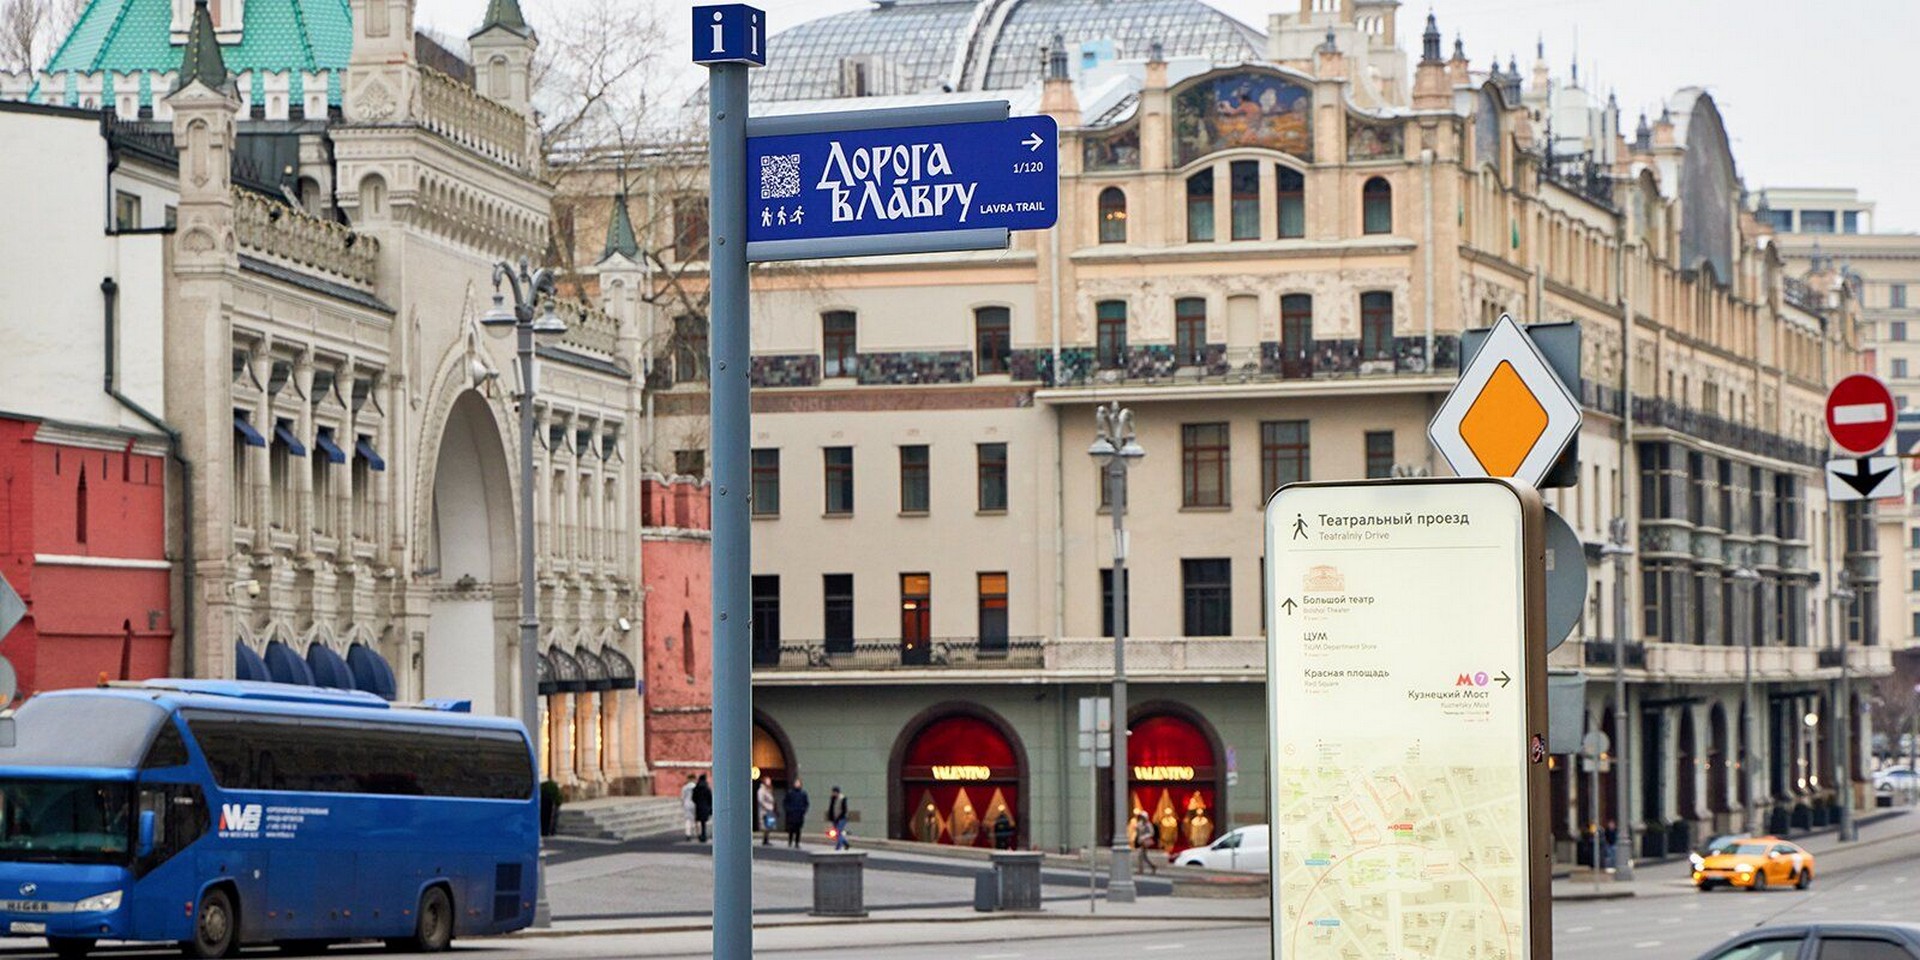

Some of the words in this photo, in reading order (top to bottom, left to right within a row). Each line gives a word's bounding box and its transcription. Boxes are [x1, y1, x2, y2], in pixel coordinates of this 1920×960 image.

[1013, 161, 1044, 174] 1/120
[980, 203, 1014, 214] LAVRA
[1016, 201, 1045, 212] TRAIL
[1318, 512, 1413, 528] Театральный
[1417, 514, 1470, 527] проезд
[1365, 531, 1390, 540] Drive
[1303, 595, 1346, 604] Большой
[1348, 596, 1375, 605] театр
[1303, 632, 1328, 642] ЦУМ
[1304, 669, 1344, 678] Красная
[1347, 670, 1390, 678] площадь
[1408, 690, 1461, 701] Кузнецкий
[1463, 690, 1489, 698] Мост
[931, 765, 991, 780] VALENTINO
[1134, 765, 1195, 780] VALENTINO
